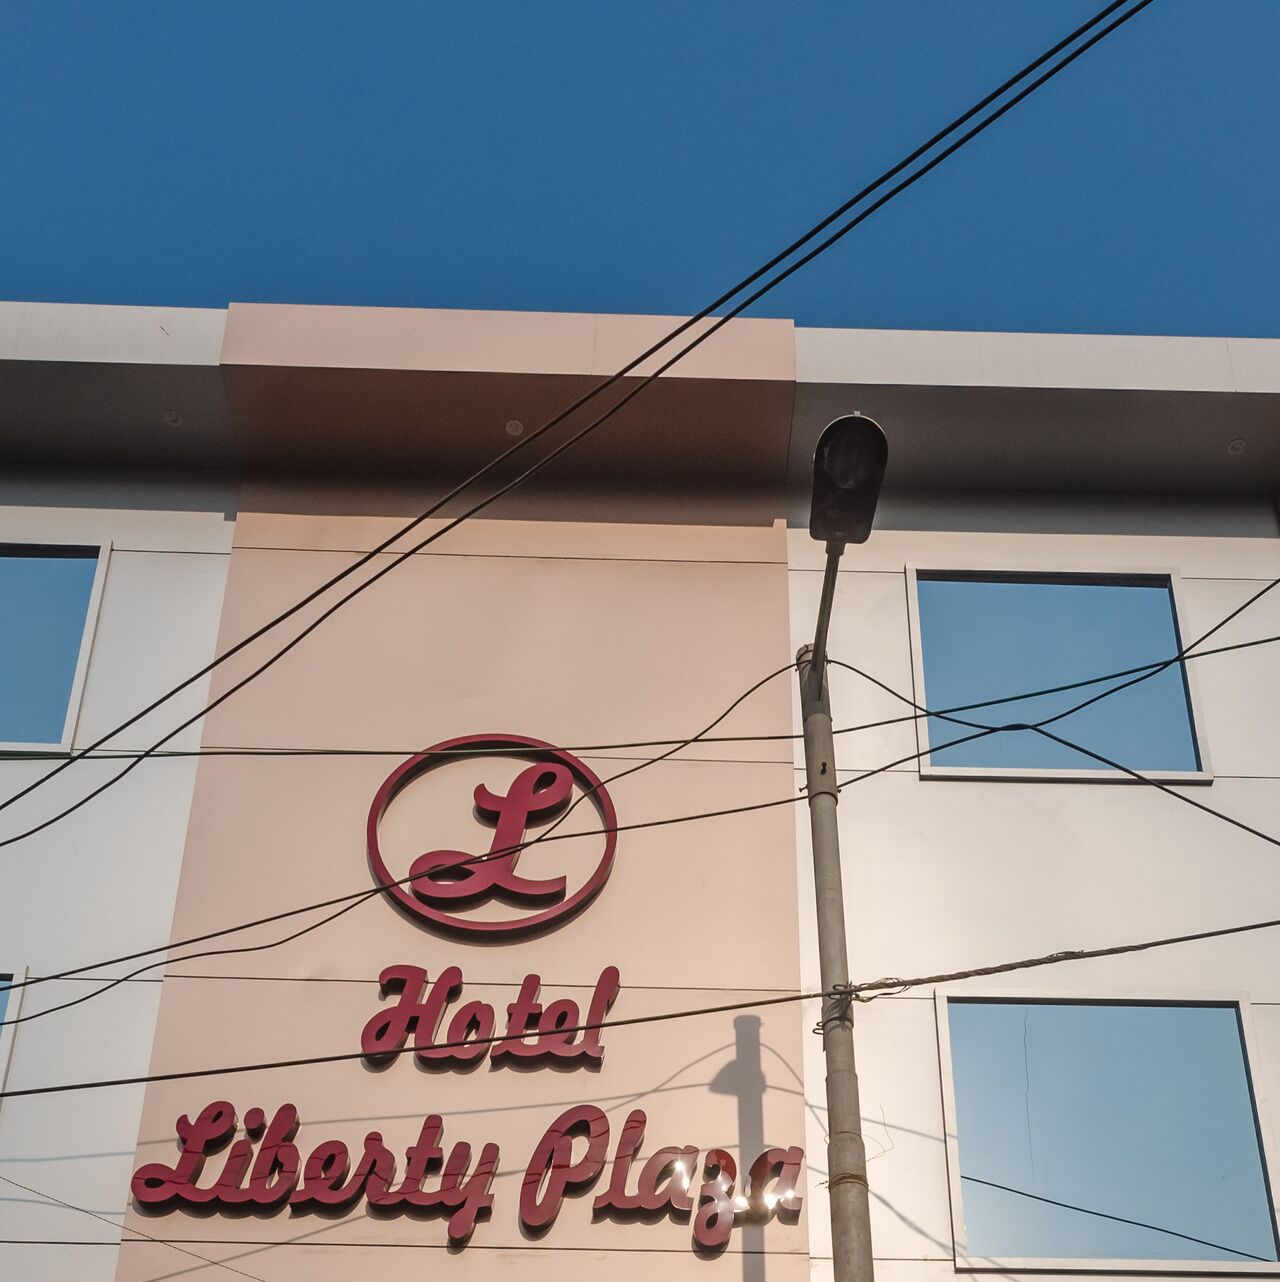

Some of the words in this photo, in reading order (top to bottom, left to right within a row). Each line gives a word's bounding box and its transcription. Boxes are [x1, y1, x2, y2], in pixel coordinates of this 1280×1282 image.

[409, 762, 574, 908] L
[361, 964, 620, 1072] Hotel
[131, 1100, 500, 1250] Liberty
[519, 1104, 804, 1258] Plaza
